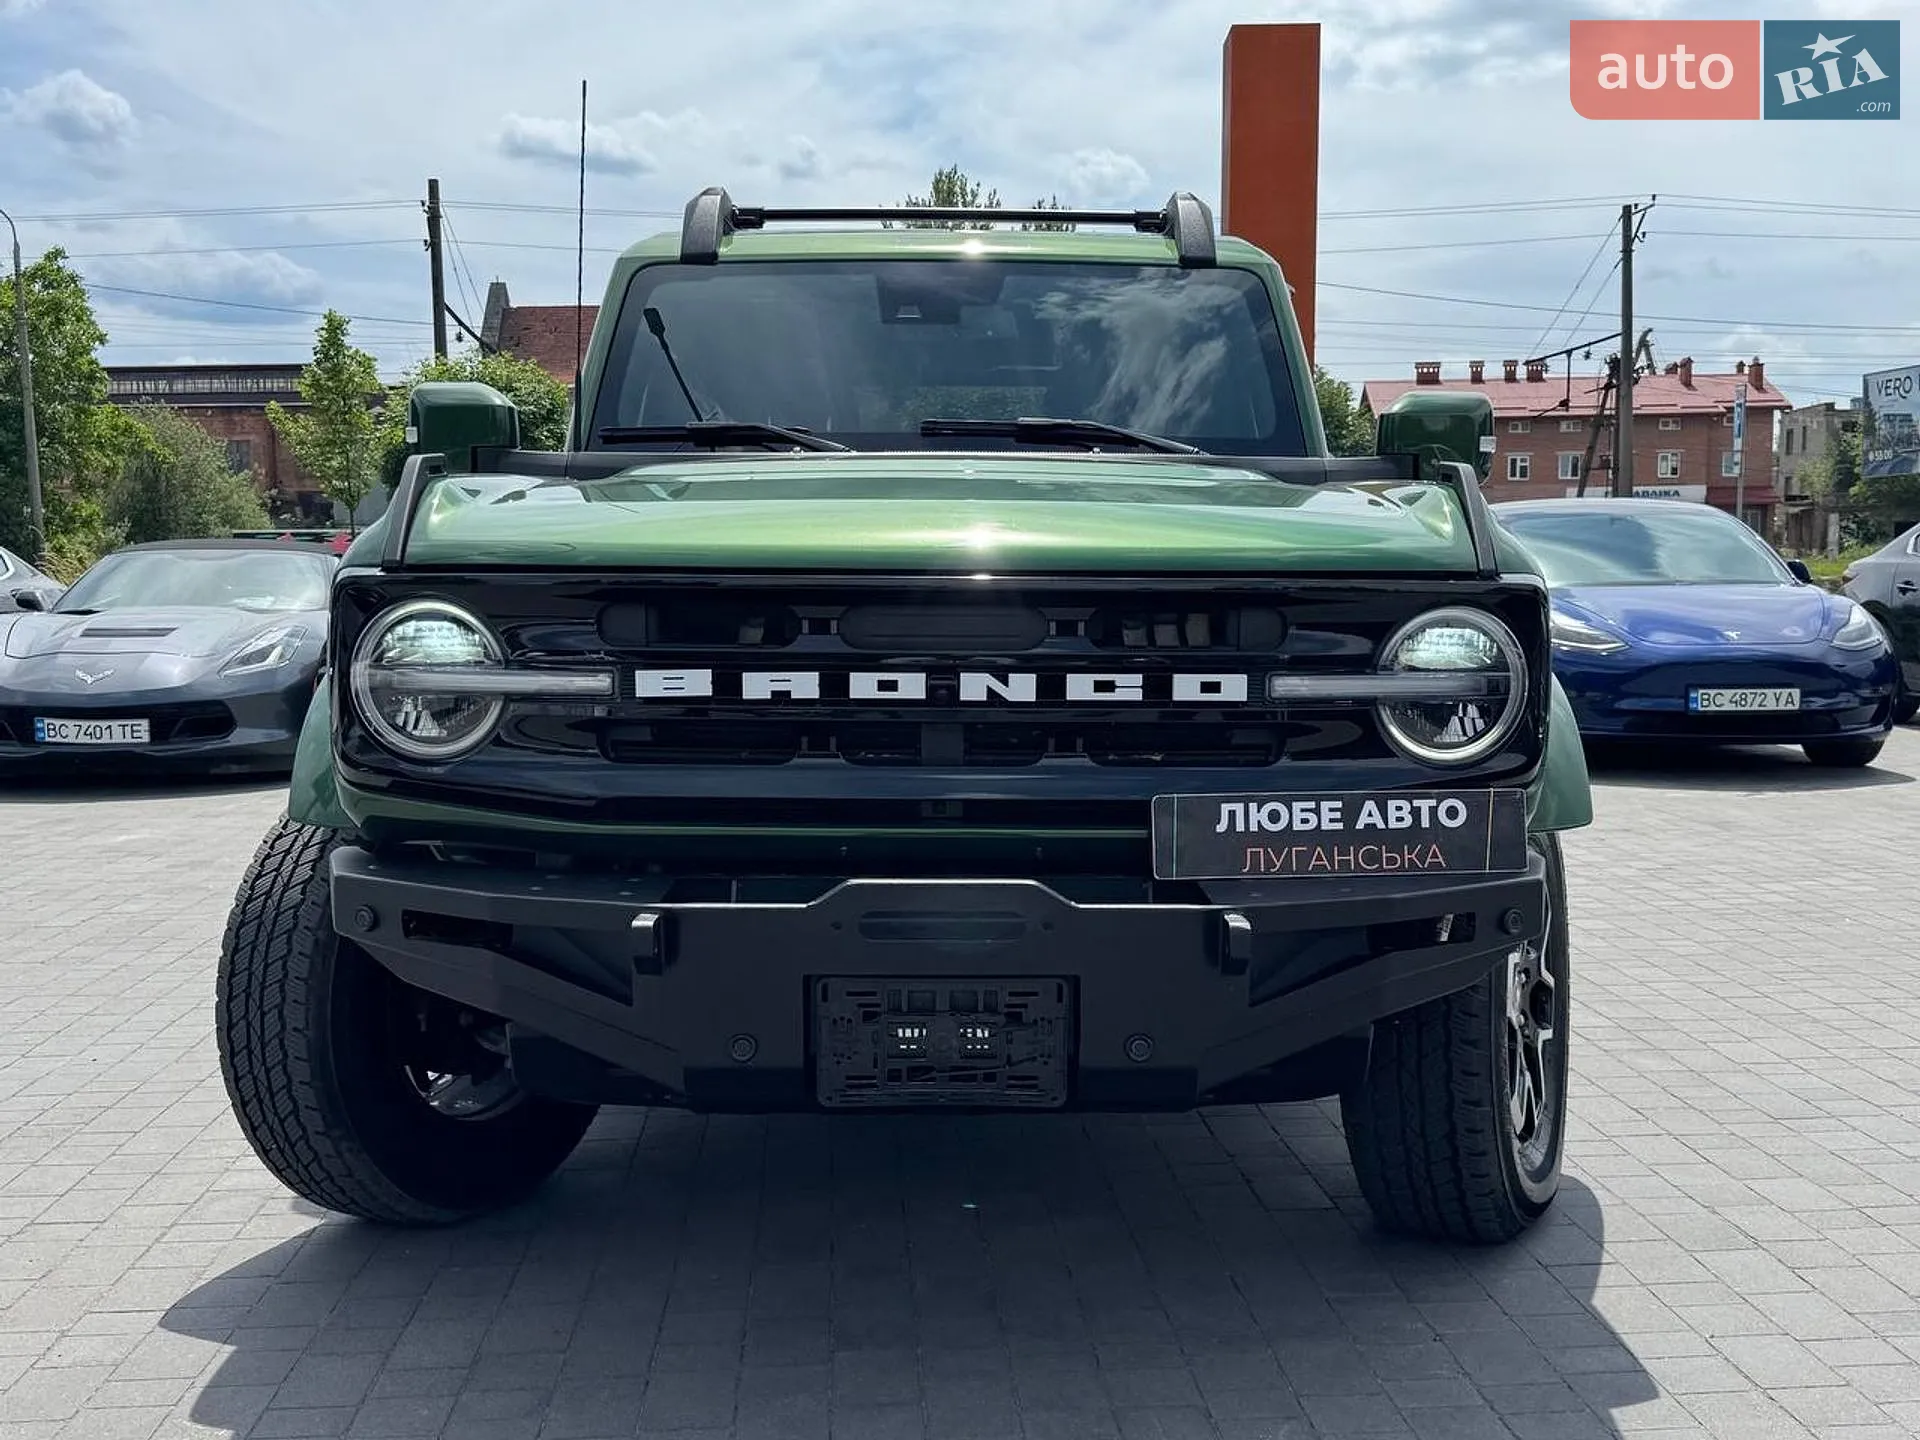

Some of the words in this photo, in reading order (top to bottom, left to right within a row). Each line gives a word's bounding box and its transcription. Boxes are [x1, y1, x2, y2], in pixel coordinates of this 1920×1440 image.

[1876, 376, 1913, 399] VERO
[635, 669, 1248, 701] BRONCO
[1700, 692, 1724, 707] BC
[1729, 692, 1767, 707] 4872
[1774, 692, 1795, 707] YA
[46, 722, 69, 739] BC
[72, 724, 113, 740] 7401
[118, 723, 143, 739] TE
[1216, 801, 1344, 832] ЛЮБЕ
[1355, 798, 1467, 829] АВТО
[1242, 844, 1447, 872] ЛУГАНСЬКА
